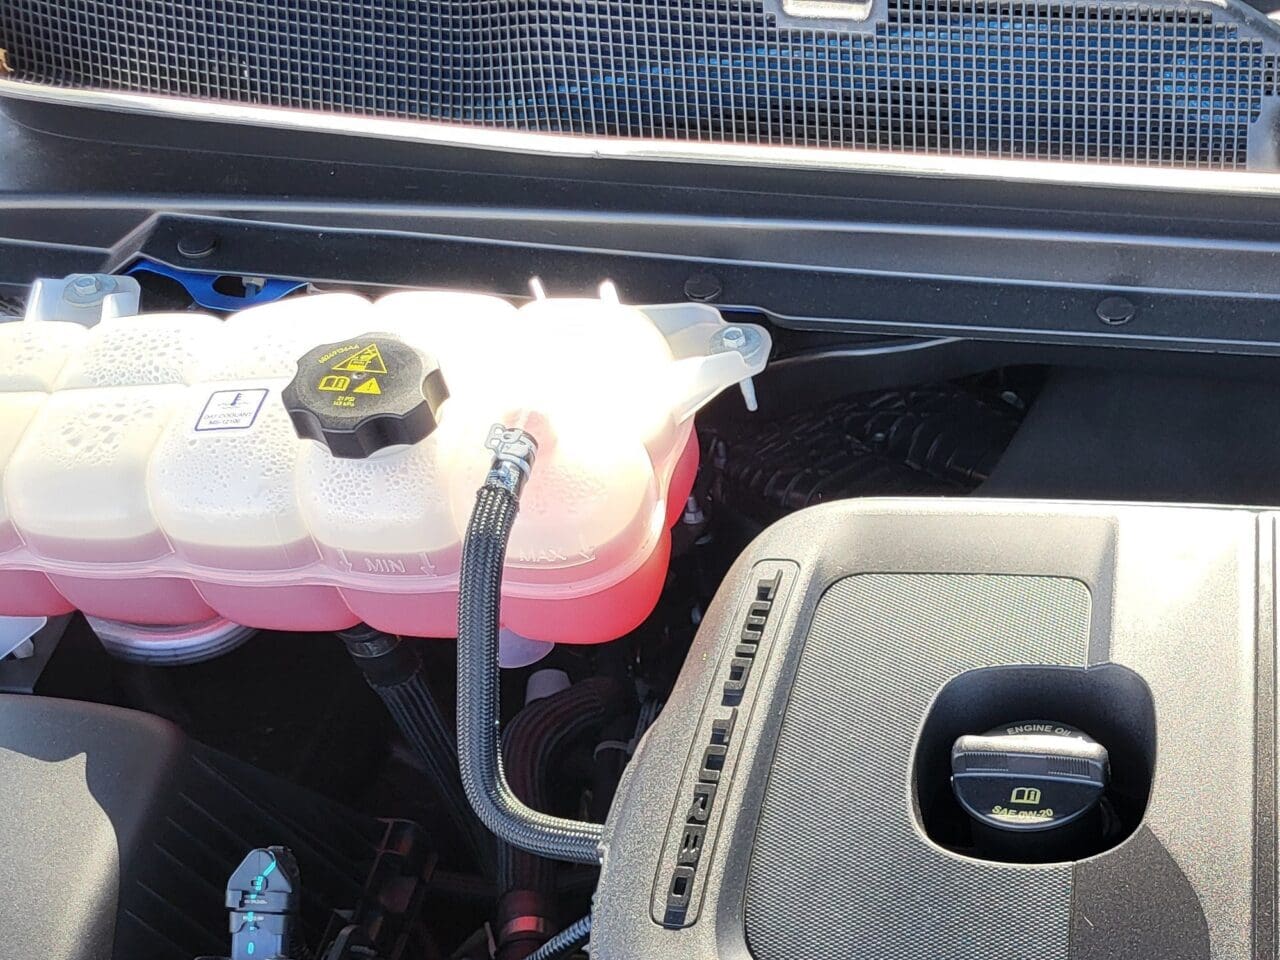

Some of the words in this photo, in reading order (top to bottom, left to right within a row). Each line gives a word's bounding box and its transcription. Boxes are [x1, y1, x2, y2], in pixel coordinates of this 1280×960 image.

[519, 549, 567, 562] MAX
[364, 557, 406, 573] MIN
[723, 568, 783, 692] TWIN
[1006, 724, 1053, 735] ENGINE
[667, 707, 739, 907] TURBO
[992, 805, 1017, 817] SAE
[1018, 808, 1054, 819] 0W-20
